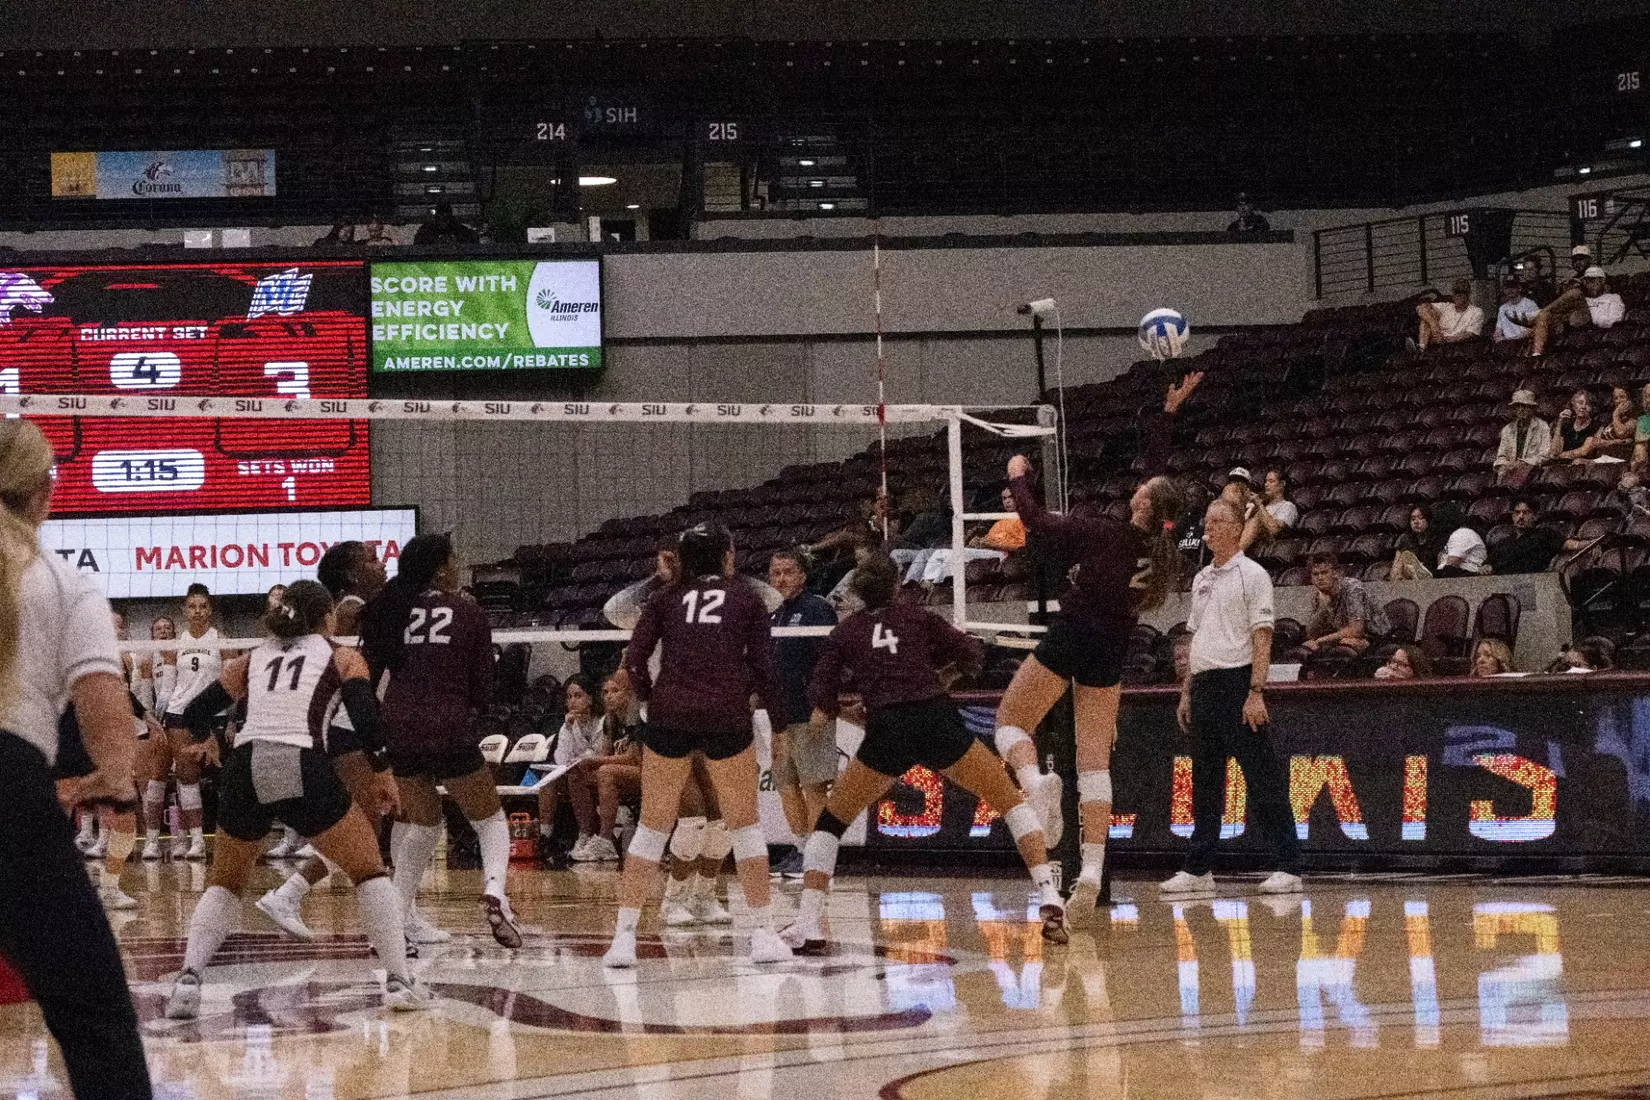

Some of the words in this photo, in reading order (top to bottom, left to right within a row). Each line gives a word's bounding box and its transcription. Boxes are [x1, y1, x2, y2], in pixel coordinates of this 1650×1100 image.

[1617, 71, 1641, 91] 215
[606, 107, 637, 123] SIH
[537, 122, 566, 140] 214
[709, 122, 738, 140] 215
[132, 180, 181, 196] Corona
[1577, 199, 1598, 219] 116
[1449, 215, 1469, 235] 115
[370, 276, 448, 294] SCORE
[455, 275, 517, 293] WITH
[371, 299, 464, 317] ENERGY
[551, 300, 598, 313] Ameren
[80, 327, 166, 341] CURRENT
[172, 326, 209, 340] SET
[372, 322, 510, 341] EFFICIENCY
[131, 356, 162, 385] 4
[383, 353, 589, 370] AMEREN.COM/REBATES
[57, 397, 87, 410] SIU
[147, 399, 176, 411] SIU
[235, 399, 263, 412] SIU
[320, 401, 347, 413] SIU
[403, 401, 431, 413] SIU
[485, 403, 511, 415] SIU
[564, 403, 590, 416] SIU
[642, 404, 667, 416] SIU
[717, 404, 741, 417] SIU
[790, 405, 815, 417] SIU
[118, 458, 179, 483] 1:15
[238, 460, 284, 475] SETS
[289, 459, 334, 474] WON
[280, 476, 297, 502] 1
[135, 543, 270, 571] MARION
[278, 539, 400, 567] TOTA
[682, 589, 726, 624] 12
[404, 606, 454, 645] 22
[872, 622, 898, 654] 4
[191, 656, 200, 672] 9
[263, 654, 307, 692] 11
[876, 755, 1556, 842] SUKIS
